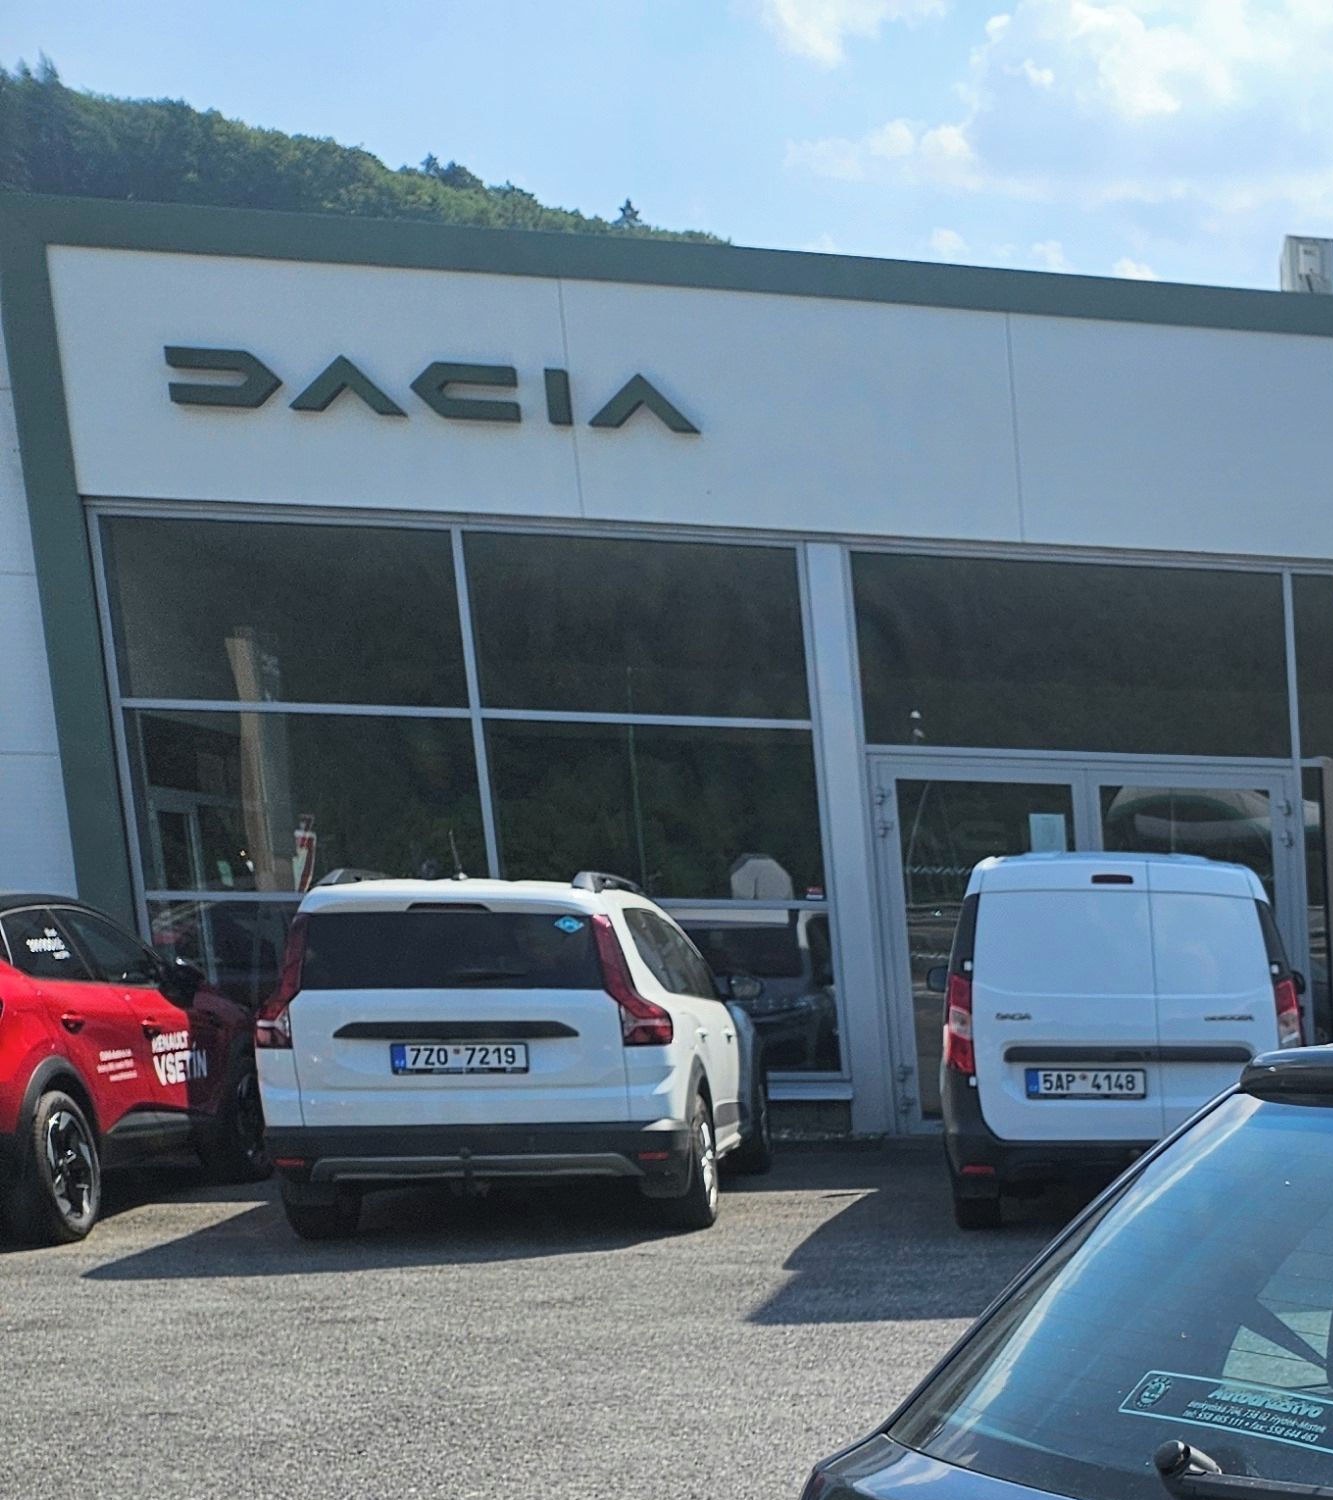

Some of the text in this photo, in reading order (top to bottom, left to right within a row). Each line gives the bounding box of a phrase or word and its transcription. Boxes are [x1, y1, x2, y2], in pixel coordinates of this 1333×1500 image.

[163, 344, 702, 435] DACIA
[153, 1041, 208, 1087] VSETÍN
[464, 1047, 517, 1066] 7219
[1042, 1072, 1137, 1092] 5AP 4148
[1228, 1415, 1244, 1427] 111
